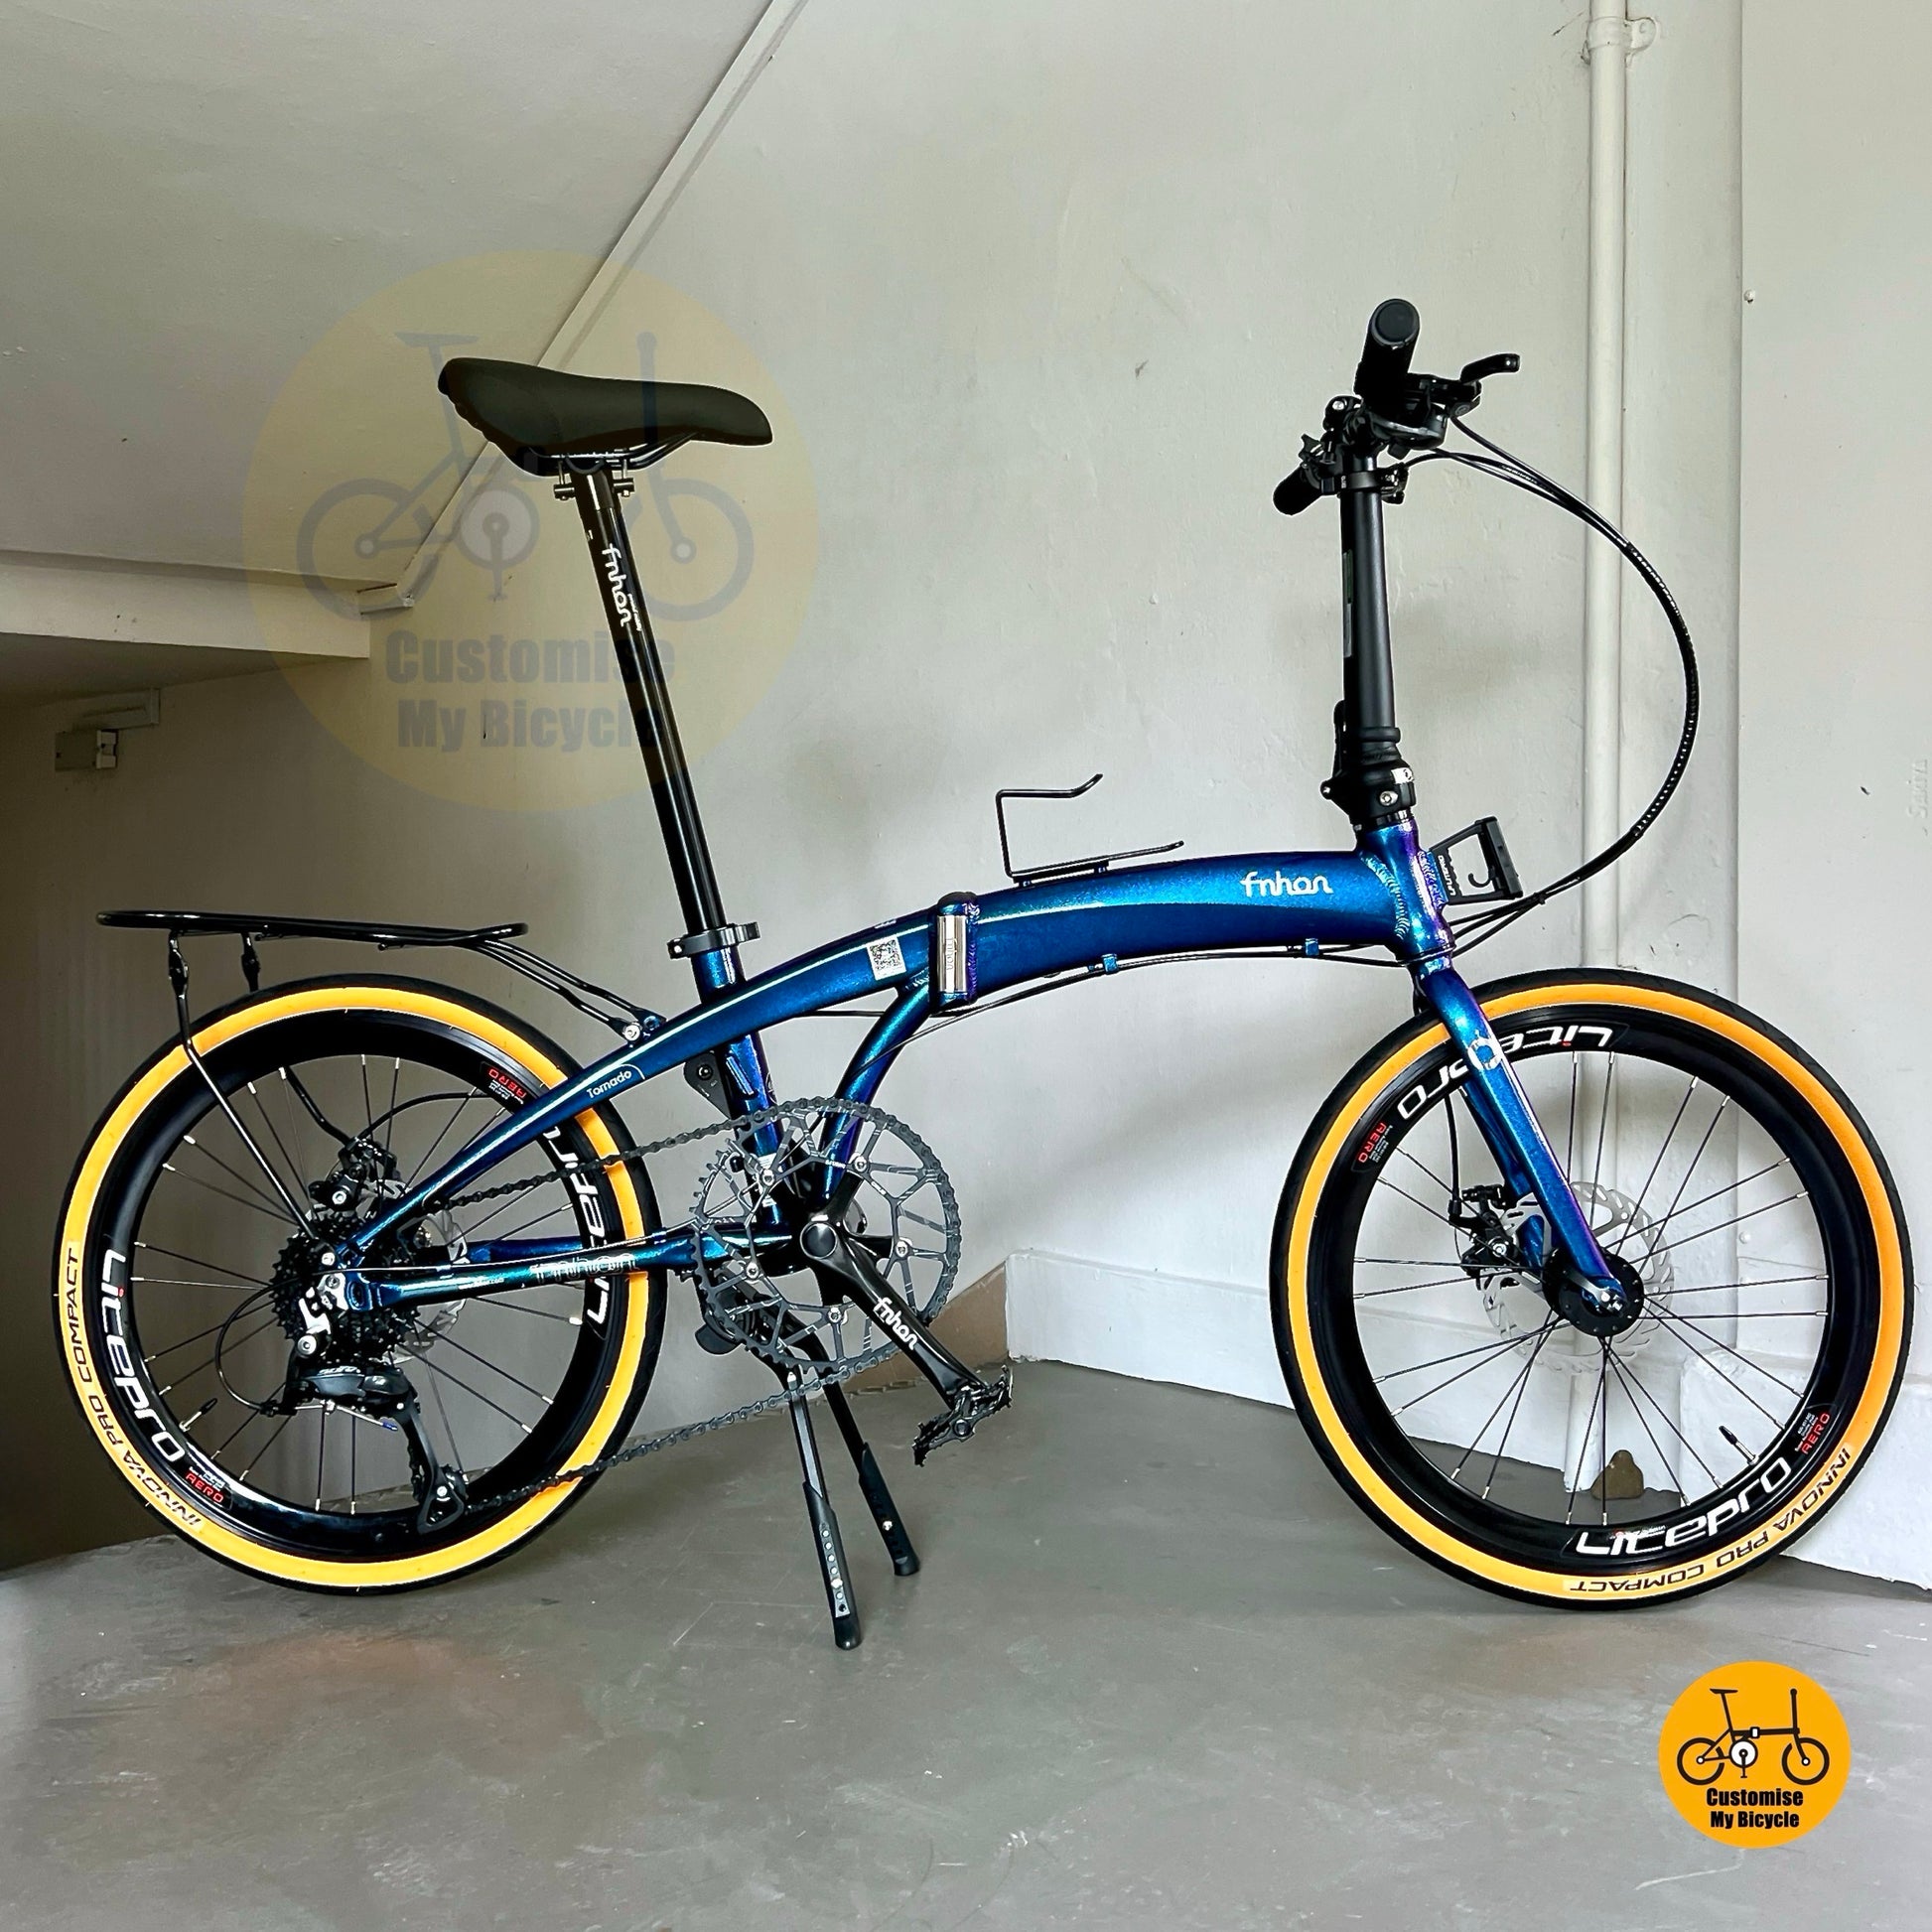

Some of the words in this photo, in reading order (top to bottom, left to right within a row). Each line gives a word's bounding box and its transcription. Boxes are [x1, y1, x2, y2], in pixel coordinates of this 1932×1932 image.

[487, 1068, 527, 1098] AERO
[586, 1070, 632, 1099] Tornado
[1358, 1122, 1387, 1163] AERO
[65, 1247, 94, 1383] COMPACT
[88, 1394, 124, 1447] PRO
[1801, 1413, 1831, 1454] AERO
[122, 1449, 203, 1527] INNOVA
[185, 1472, 224, 1503] AERO
[1772, 1448, 1851, 1532] INNOVA
[1716, 1530, 1770, 1568] PRO
[1570, 1564, 1705, 1592] COMPACT
